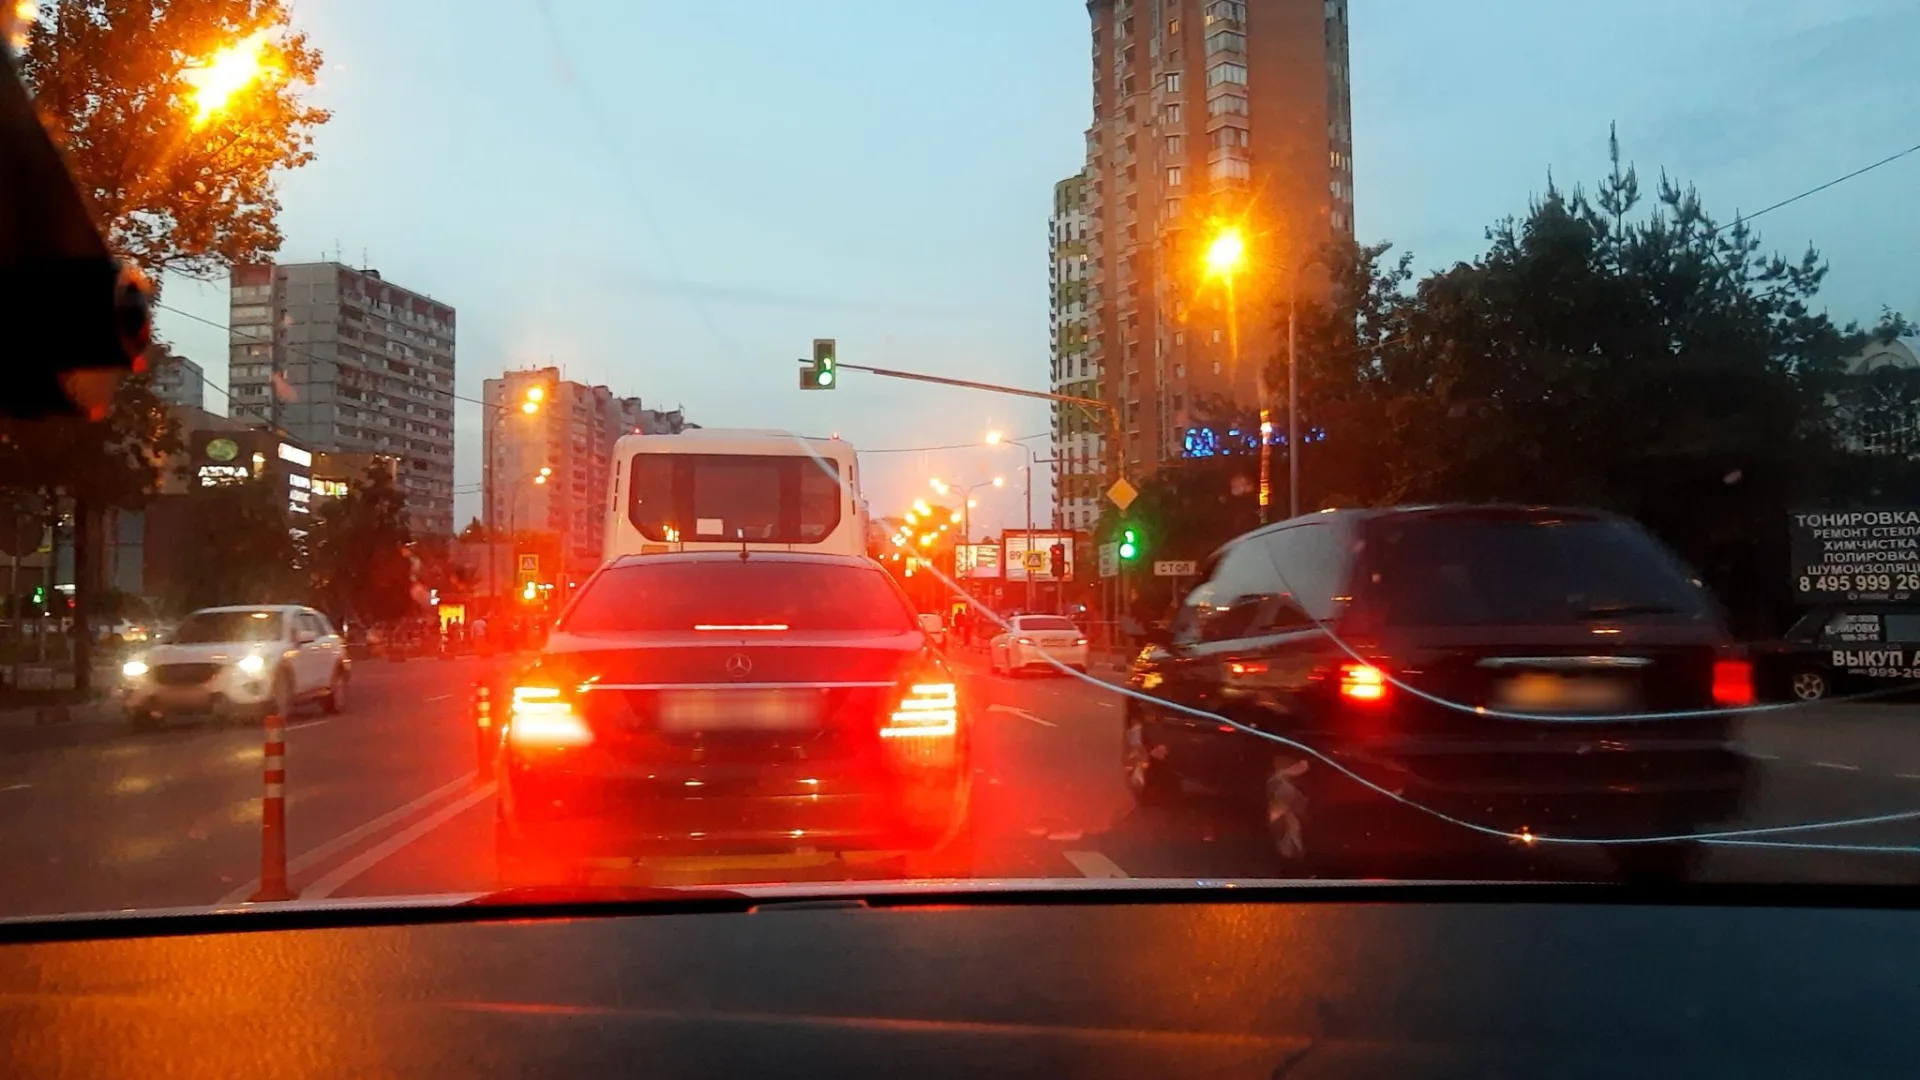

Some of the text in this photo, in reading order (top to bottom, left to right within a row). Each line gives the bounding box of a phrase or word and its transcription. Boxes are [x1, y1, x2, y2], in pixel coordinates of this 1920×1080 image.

[1795, 511, 1920, 527] ТОНИРОВКА
[1813, 526, 1920, 539] РЕМОНТ СТЕКЛА
[1823, 539, 1918, 551] ХИМЧИСТКА
[1824, 551, 1918, 563] ПОЛИРОВКА
[1799, 576, 1810, 592] 8
[1816, 575, 1850, 591] 495
[1855, 575, 1890, 591] 999
[1832, 650, 1903, 667] ВЫКУП
